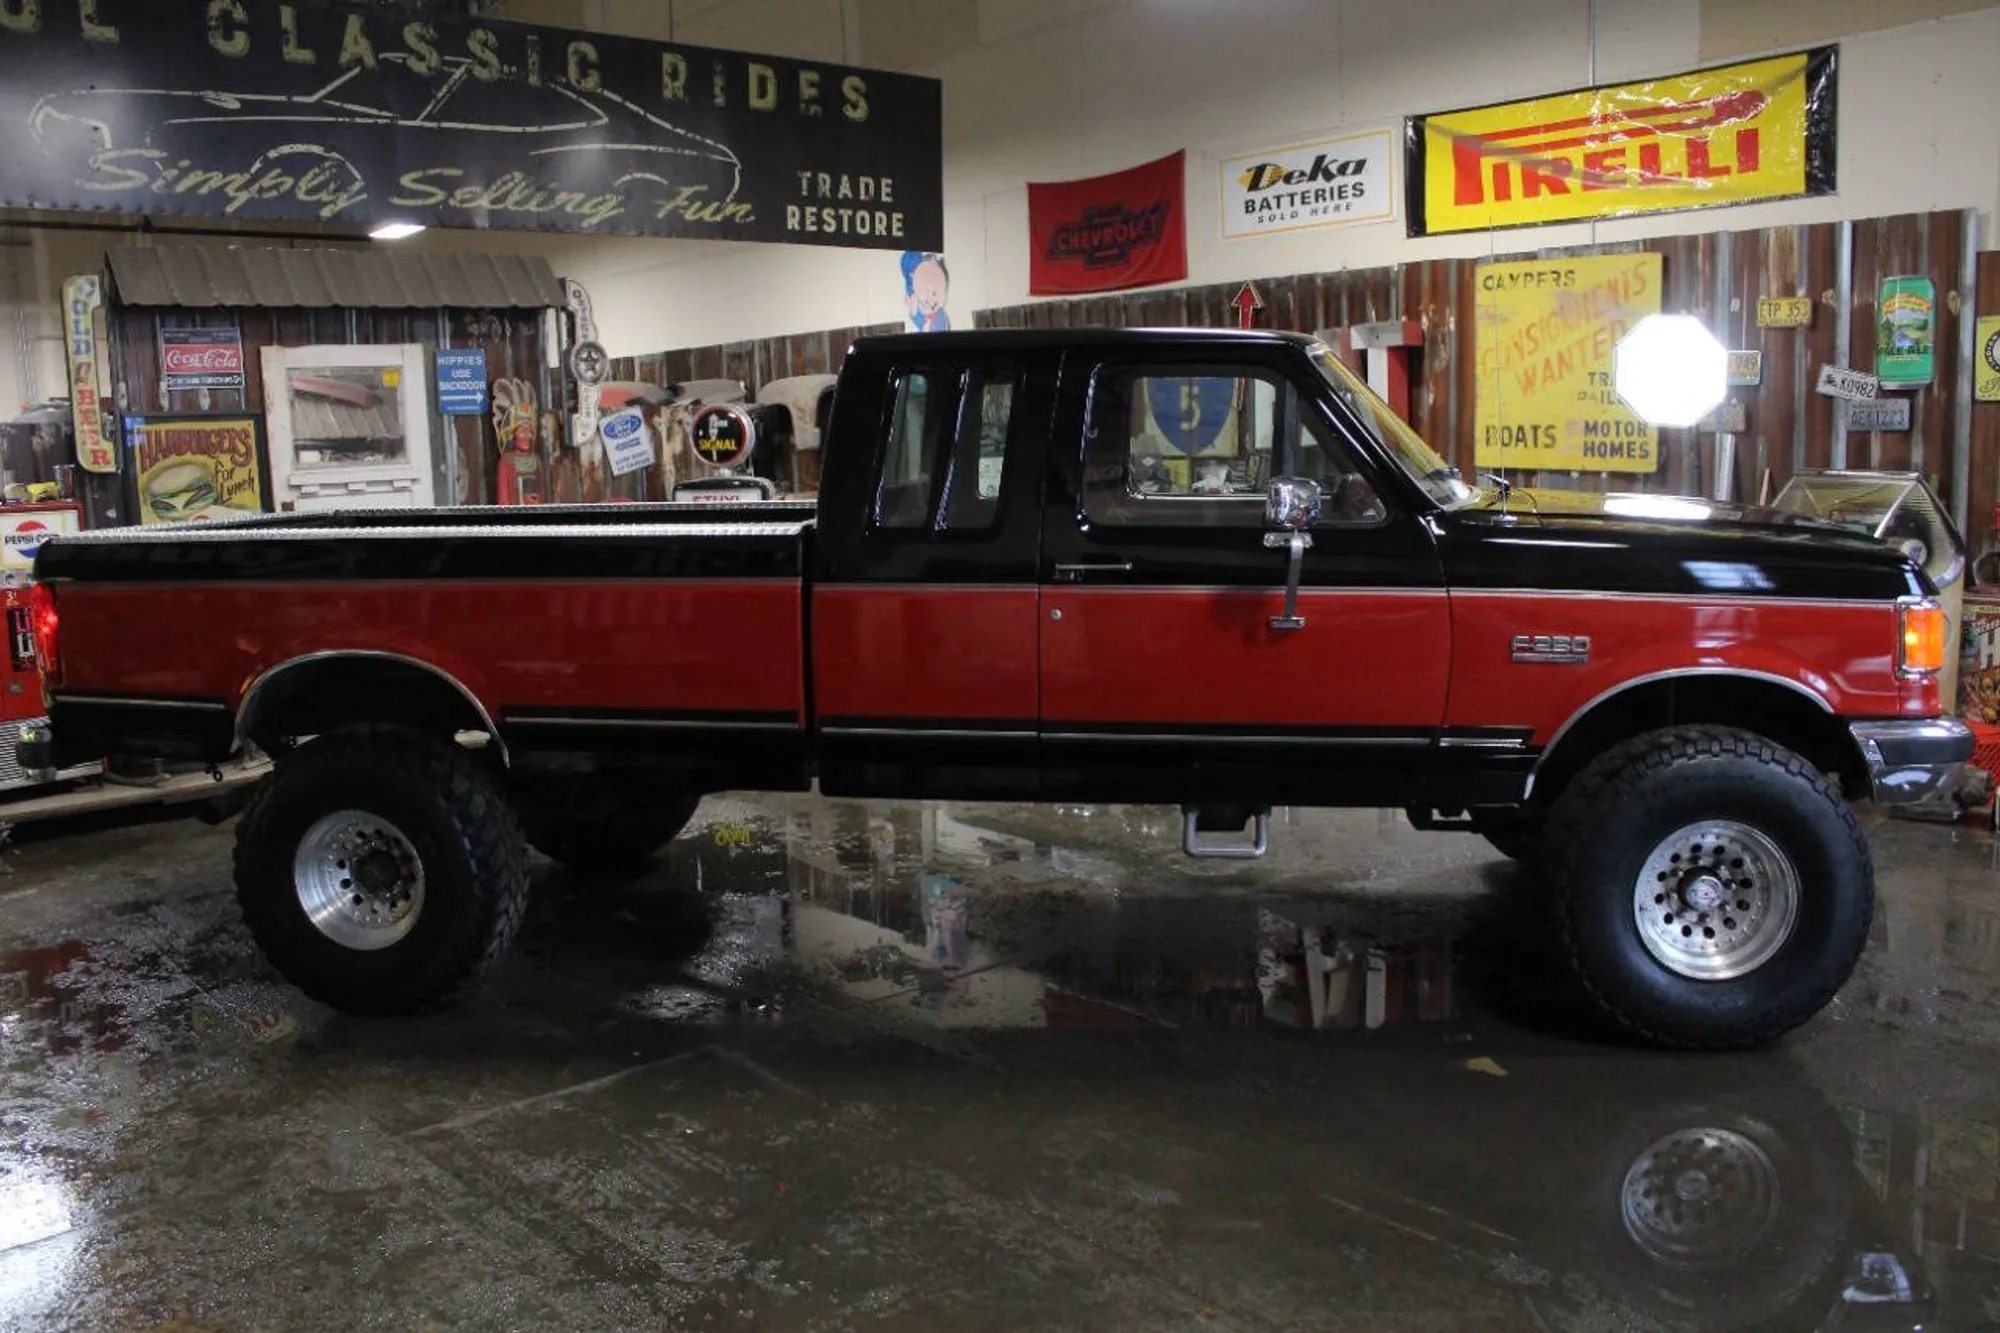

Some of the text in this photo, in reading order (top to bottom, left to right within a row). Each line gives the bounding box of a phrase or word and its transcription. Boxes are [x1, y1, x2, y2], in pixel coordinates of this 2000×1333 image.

[207, 0, 600, 92] CLASSIC
[662, 52, 870, 122] RIDES
[1452, 89, 1766, 206] PIRELLI
[74, 148, 756, 228] Simply Selling Fun
[798, 170, 894, 203] TRADE
[1240, 152, 1369, 193] Deka
[1244, 180, 1365, 215] BATTERIES
[1257, 202, 1353, 224] SOLD HERE
[786, 206, 904, 238] RESTORE
[1056, 215, 1164, 254] CHEVROLET
[437, 356, 483, 366] HIPPIES
[451, 369, 472, 378] USE
[438, 381, 487, 390] BACKDOOR
[1180, 385, 1201, 431] 5
[699, 438, 737, 450] SIGNAL
[1583, 420, 1649, 438] MOTOR
[1582, 440, 1650, 459] HOMES
